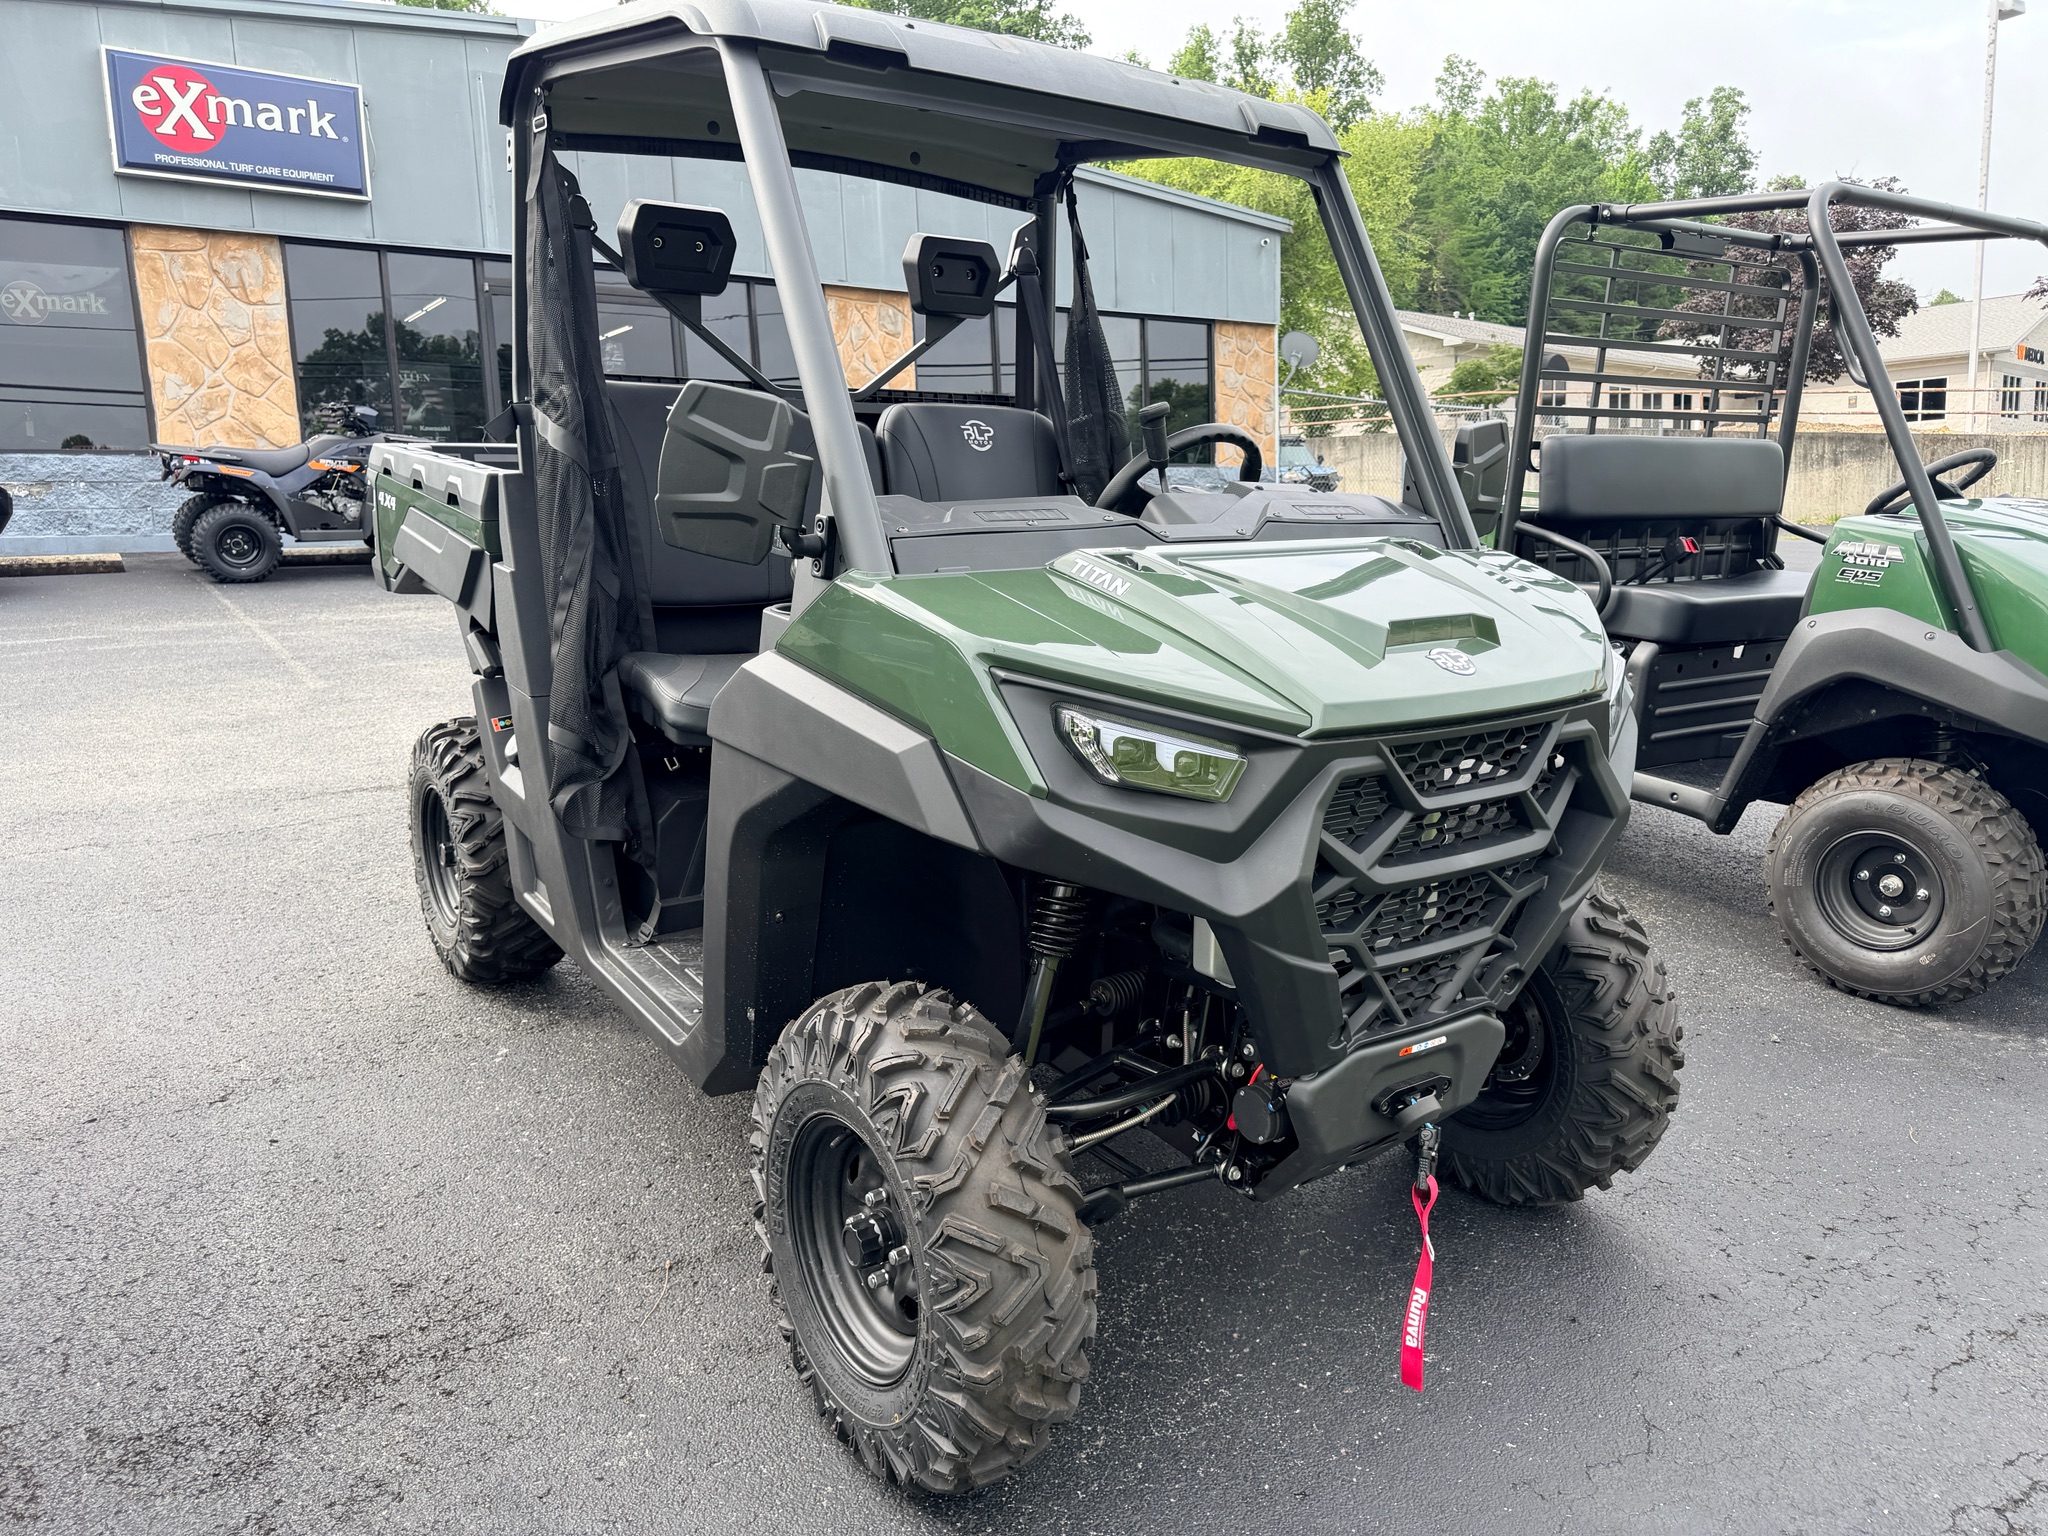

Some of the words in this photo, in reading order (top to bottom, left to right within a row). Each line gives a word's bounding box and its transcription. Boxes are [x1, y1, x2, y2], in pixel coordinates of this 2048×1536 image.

[154, 153, 229, 171] PROFESSIONAL
[229, 162, 254, 173] TURF
[255, 165, 281, 176] CARE
[282, 169, 335, 183] EQUIPMENT
[1830, 540, 1905, 563] MULE
[1843, 555, 1890, 568] 4010
[1070, 558, 1132, 597] TITAN
[1885, 803, 1964, 859] DURO
[1405, 1286, 1428, 1348] Runva
